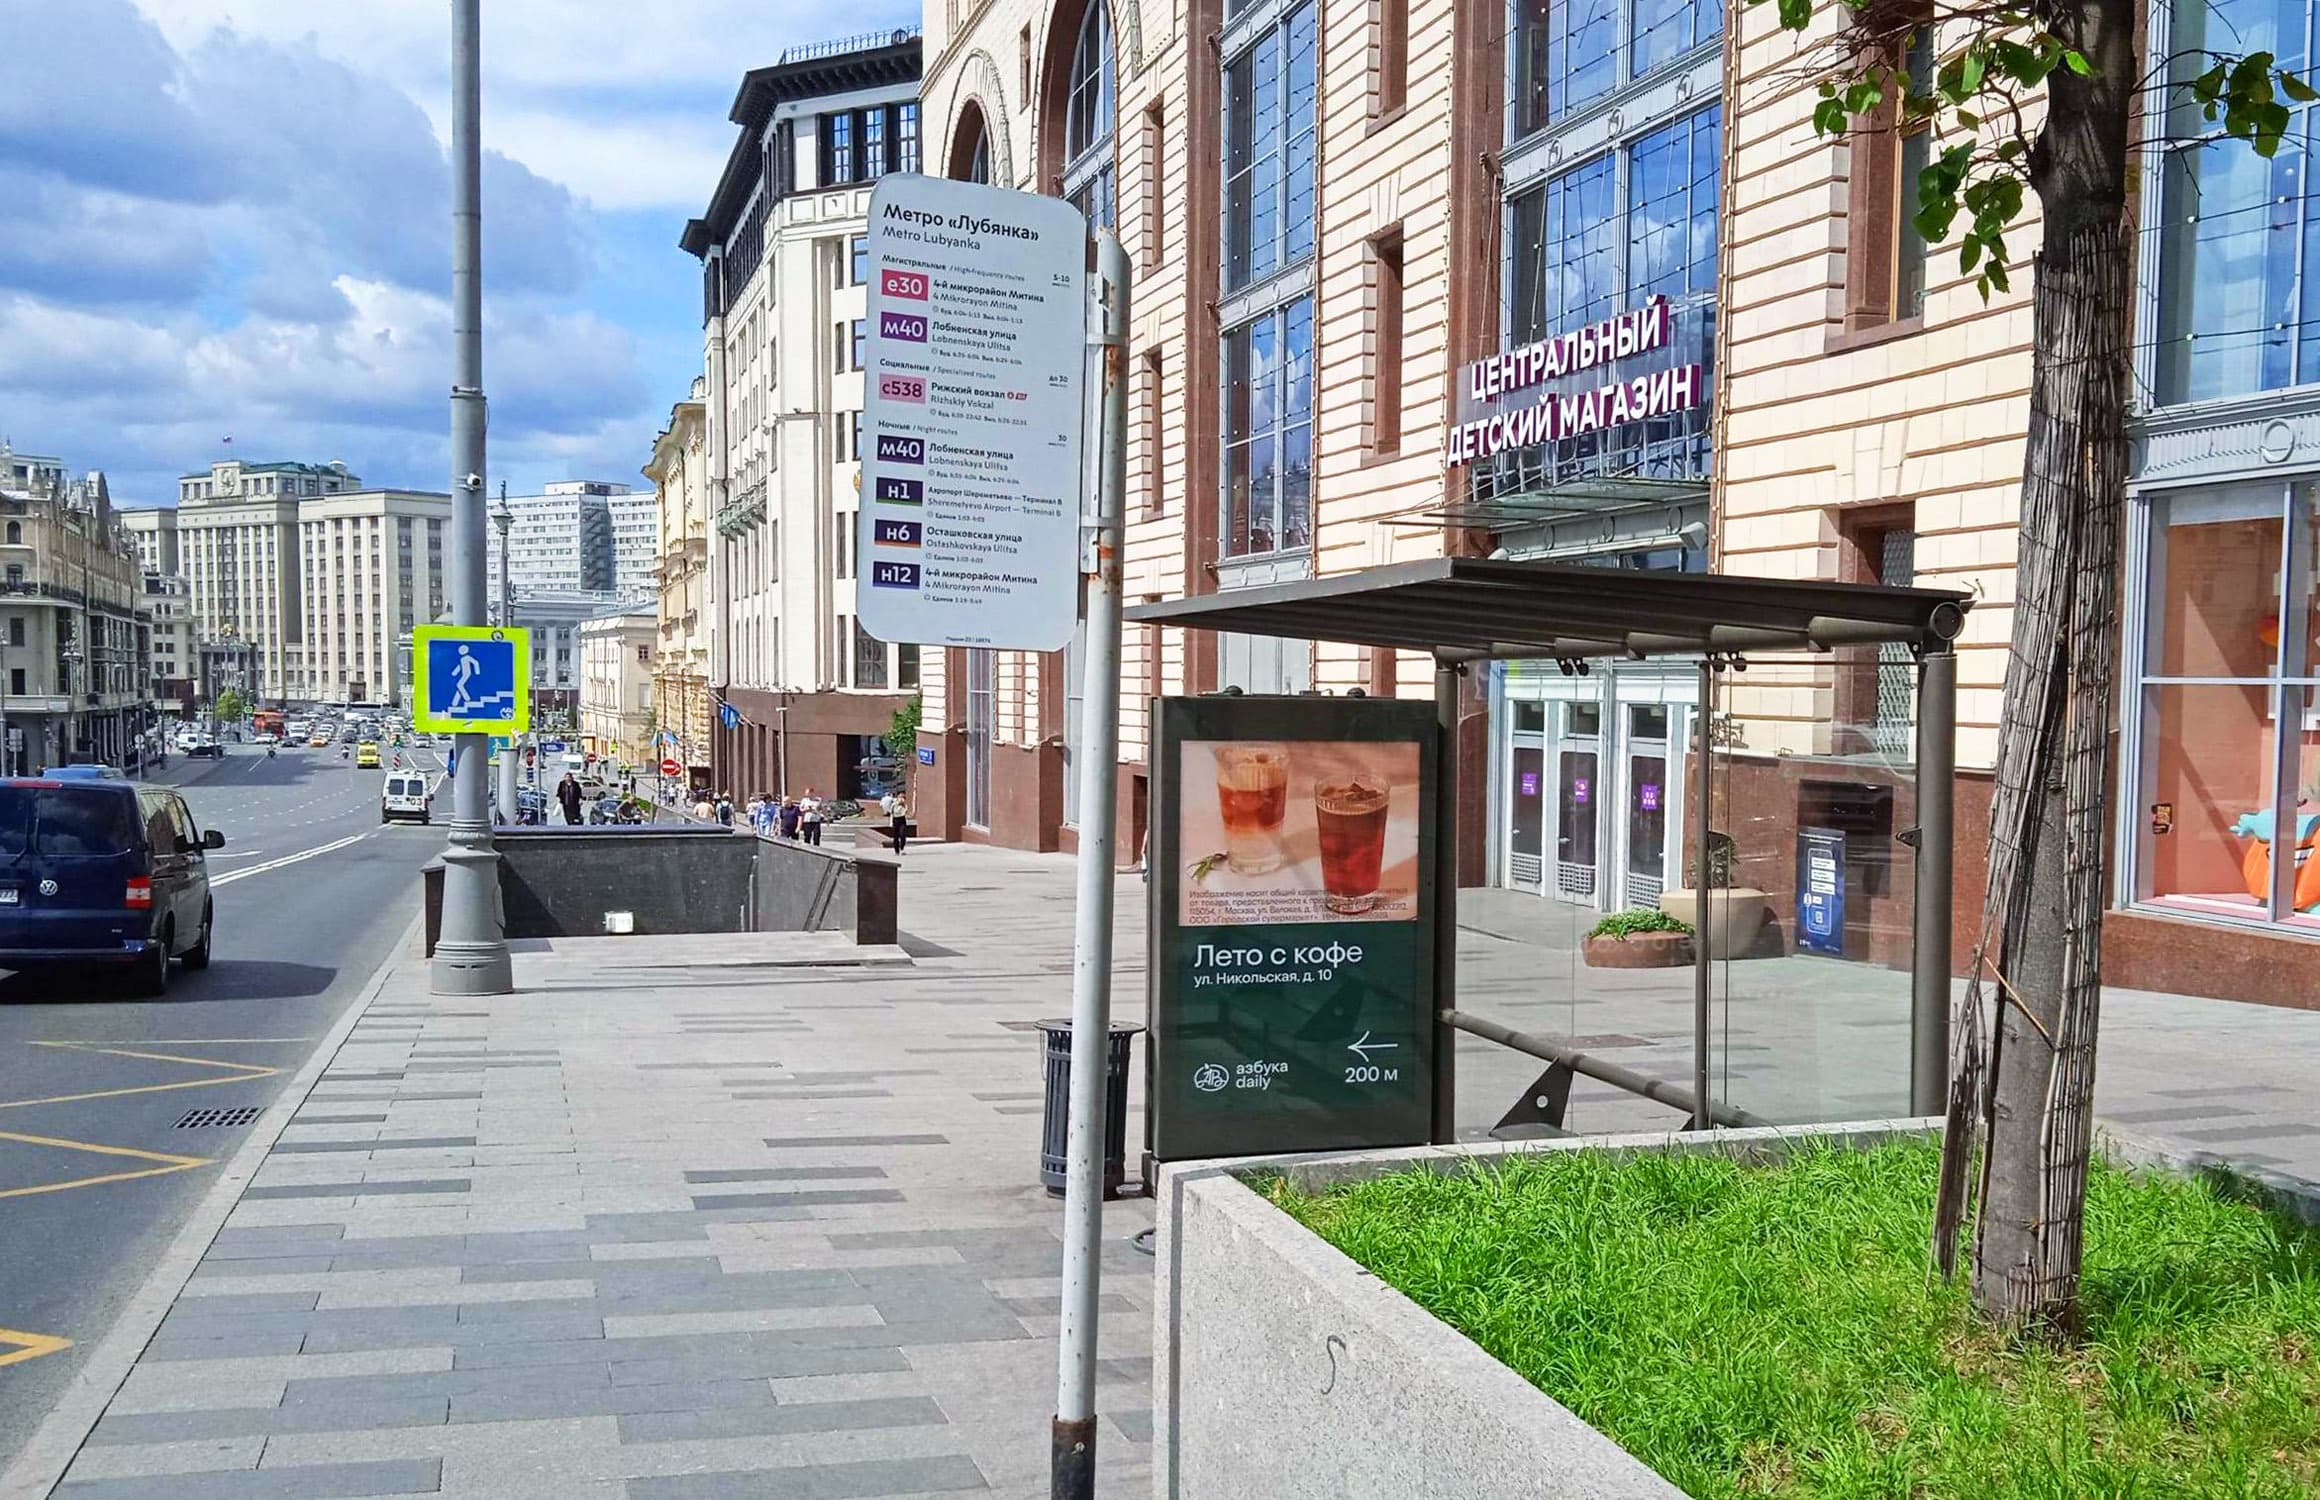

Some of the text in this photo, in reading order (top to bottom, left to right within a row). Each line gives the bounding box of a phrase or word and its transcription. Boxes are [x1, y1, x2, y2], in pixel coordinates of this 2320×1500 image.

[883, 203, 1039, 241] Метро «Лубянка»
[883, 226, 980, 250] Metro Lubyanka
[882, 254, 946, 270] Магистральные
[933, 279, 1044, 302] 4-й микрорайон Митина
[940, 293, 989, 308] Mikrorayon
[990, 300, 1017, 311] Mitina
[884, 321, 923, 338] м40
[932, 321, 1017, 341] Лобненская улица
[932, 335, 1011, 351] Lobnenskaya Ulitsa
[1471, 294, 1666, 403] ЦЕНТРАЛЬНЫЙ
[880, 358, 930, 371] Социальные
[882, 381, 922, 398] с538
[931, 382, 972, 396] Рижский
[974, 389, 1005, 399] вокзал
[931, 395, 994, 409] Rizhskiy Vokzal
[1447, 364, 1697, 467] ДЕТСКИЙ МАГАЗИН
[878, 419, 910, 431] Ночные
[881, 441, 920, 458] м40
[929, 443, 1014, 462] Лобненская улица
[929, 457, 1008, 471] Lobnenskaya Ulitsa
[887, 482, 911, 499] н1
[928, 486, 962, 498] Аэропорт
[963, 489, 1013, 501] Шереметьево
[1022, 495, 1055, 505] Терминал
[928, 498, 982, 511] Sheremetyevo
[984, 503, 1012, 514] Airport
[1023, 507, 1055, 516] Terminal
[886, 525, 910, 541] н6
[927, 526, 1022, 543] Осташковская улица
[926, 539, 1018, 554] Ostashkovskaya Ulitsa
[881, 566, 911, 583] н12
[925, 567, 1038, 585] 4-й микрорайон Митина
[932, 581, 981, 593] Mikrorayon
[982, 585, 1011, 595] Mitina
[1194, 941, 1363, 968] Лето с кофе
[1194, 969, 1332, 988] ул. Никольская, д. 10
[1236, 1060, 1288, 1077] азбука
[1345, 1066, 1379, 1083] 200
[1236, 1075, 1271, 1091] daily
